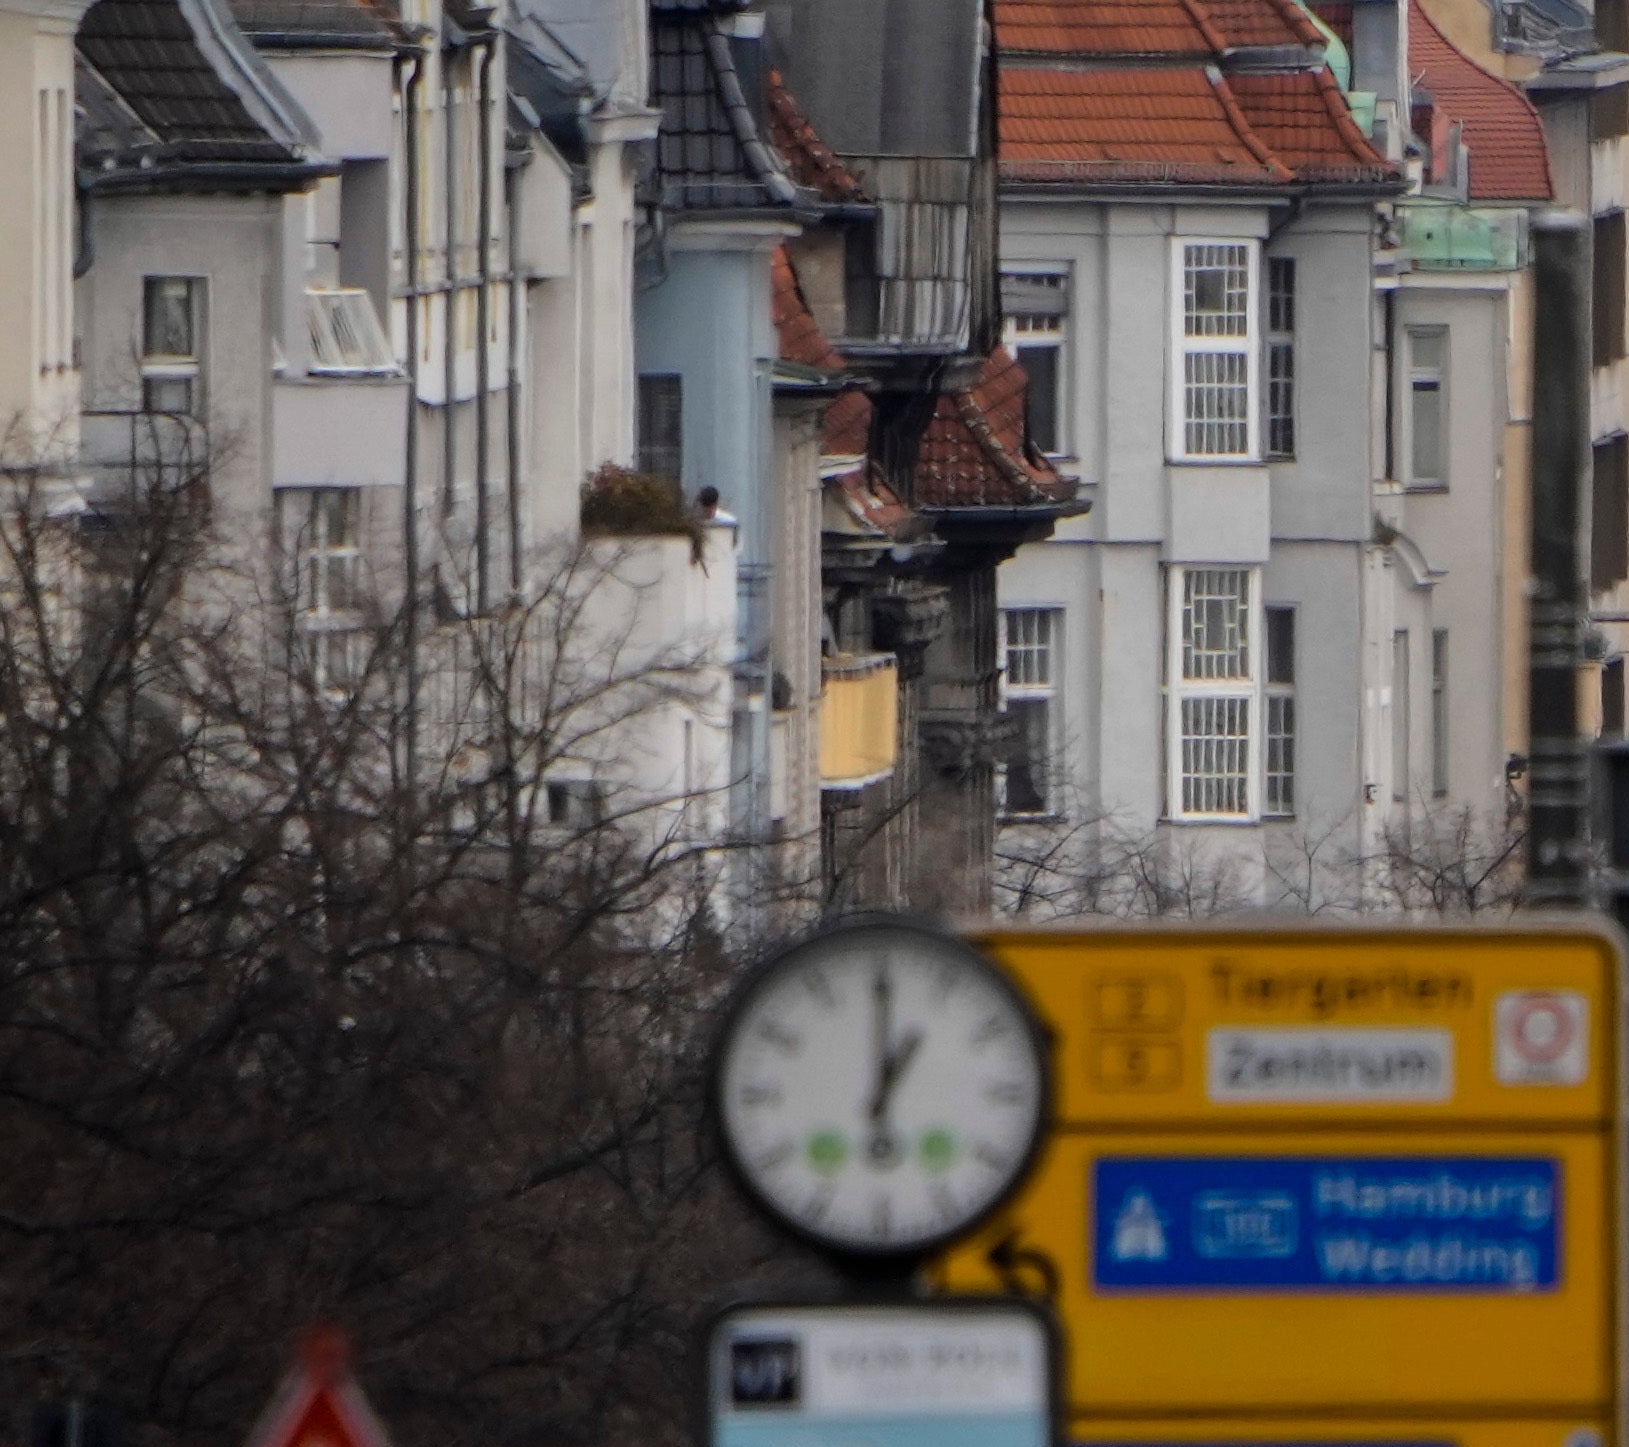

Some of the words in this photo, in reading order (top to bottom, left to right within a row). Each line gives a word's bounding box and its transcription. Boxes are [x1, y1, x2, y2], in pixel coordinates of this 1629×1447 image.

[1206, 957, 1475, 1018] Tiergarten
[1222, 1038, 1438, 1090] Zentrum
[1316, 1169, 1551, 1232] Hamburg
[1316, 1233, 1541, 1294] Wedding
